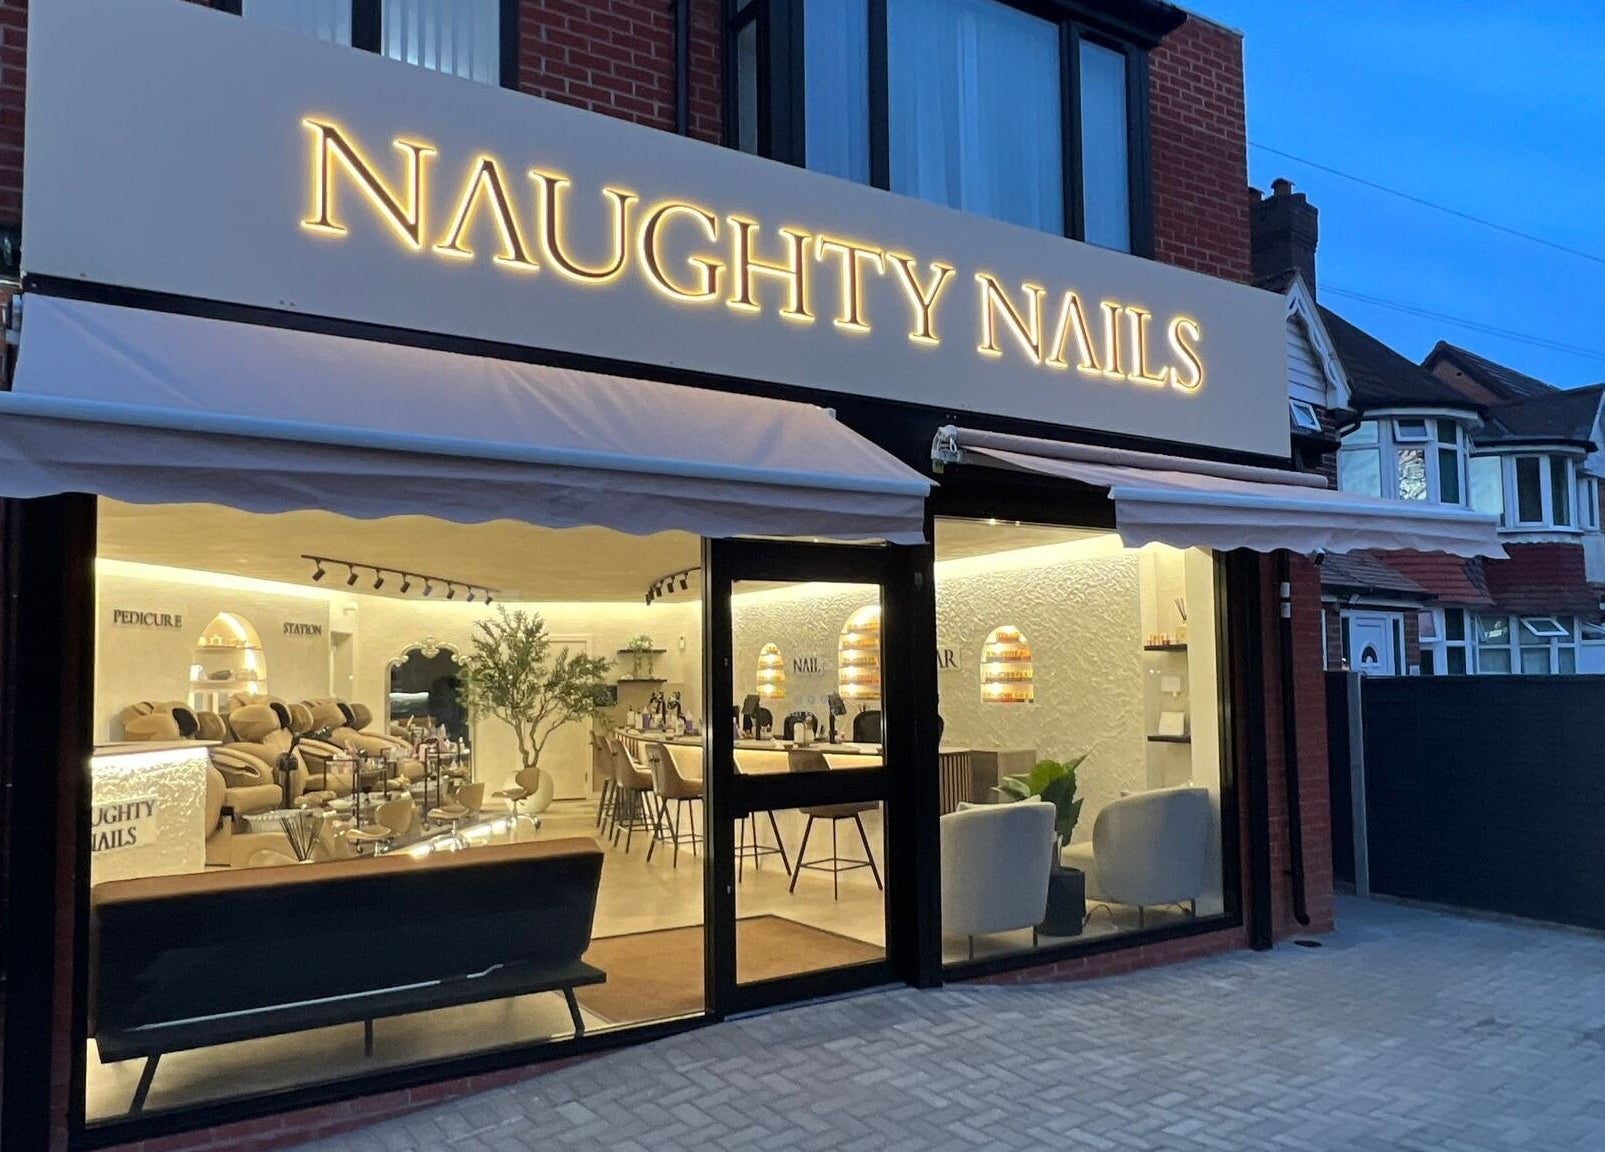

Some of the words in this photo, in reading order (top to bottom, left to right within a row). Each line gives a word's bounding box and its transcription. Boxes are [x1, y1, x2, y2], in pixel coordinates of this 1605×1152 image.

[301, 118, 956, 345] NAUGHTY
[975, 273, 1203, 393] NAILS
[113, 609, 182, 628] PEDICURE
[283, 622, 322, 635] STATION
[793, 657, 821, 673] NAIL
[92, 799, 156, 827] UGHTY
